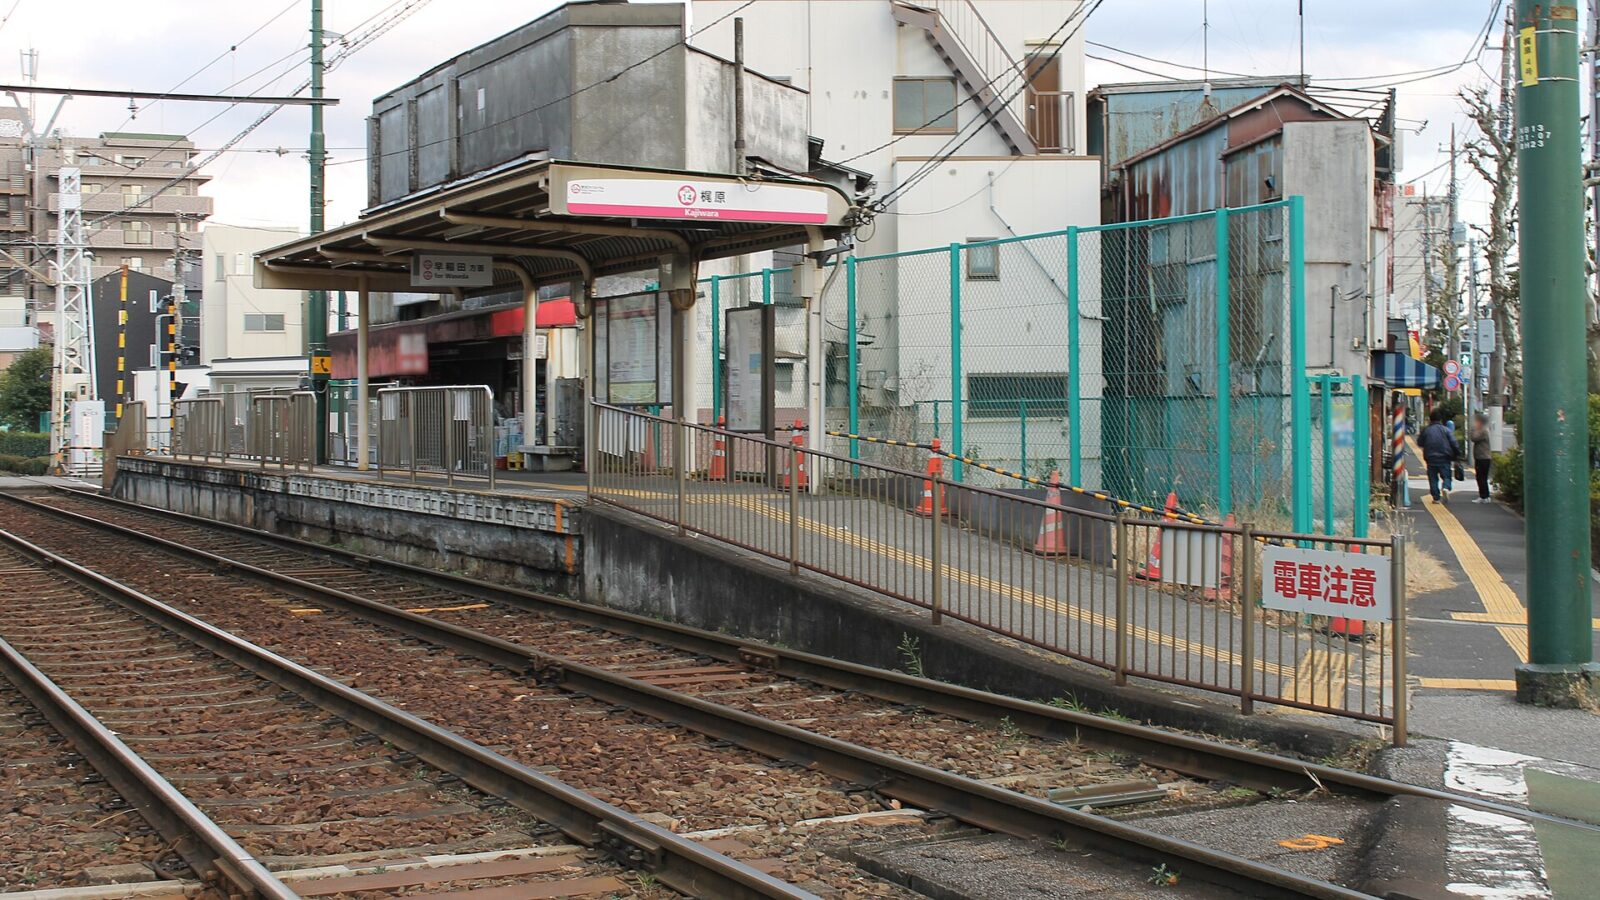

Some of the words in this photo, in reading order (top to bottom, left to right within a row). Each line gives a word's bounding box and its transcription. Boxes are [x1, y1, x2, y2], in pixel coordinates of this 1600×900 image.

[700, 190, 726, 204] 梶原
[684, 208, 719, 219] Kajiwara
[1273, 560, 1377, 608] 電車注意
